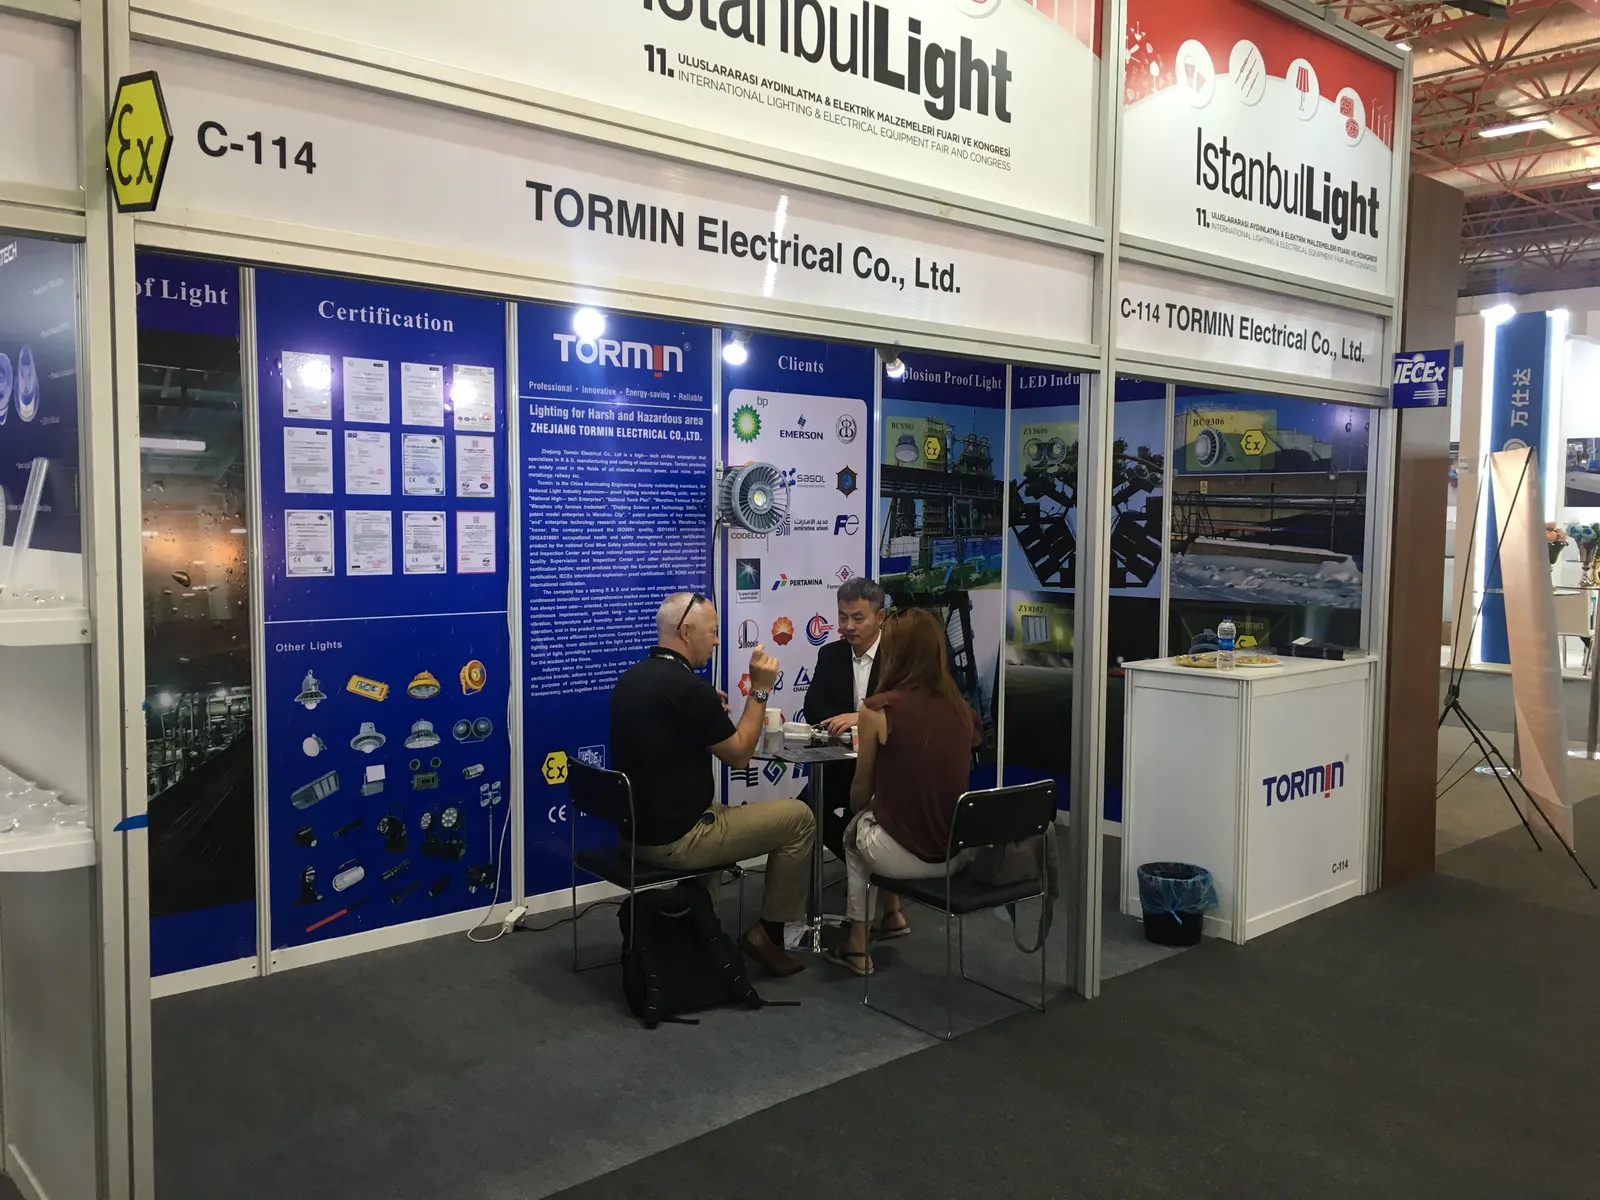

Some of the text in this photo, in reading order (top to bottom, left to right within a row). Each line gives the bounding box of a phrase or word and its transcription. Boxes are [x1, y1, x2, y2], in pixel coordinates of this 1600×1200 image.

[643, 0, 1012, 123] anbulLight
[644, 44, 674, 78] 11.
[678, 52, 1011, 158] ULUSLARARASI AYDINLATMA & ELEKTRİK MALZEMELERİ FUARI VE KONGRESİ
[678, 70, 1011, 171] INTERNATIONAL LIGHTING & ELECTRICAL EQUIPMENT FAIR AND CONGRESS
[196, 120, 316, 174] C-114
[1196, 127, 1380, 240] IstanbulLight
[1196, 208, 1210, 228] 11.
[526, 180, 960, 293] TORMIN Electrical Co., Ltd.
[1211, 212, 1249, 228] ULUSLARARASI
[1250, 222, 1280, 236] AYDINLATMA
[1338, 246, 1350, 255] FUARI
[1211, 222, 1251, 240] INTERNATIONAL
[1253, 234, 1275, 246] LIGHTING
[1280, 241, 1307, 254] ELECTRICAL
[1308, 248, 1333, 261] EQUIPMENT
[160, 279, 228, 308] Light
[318, 300, 454, 333] Certification
[1121, 297, 1365, 363] C-114 TORMIN Electrical Co., Ltd.
[778, 355, 824, 374] Clients
[1394, 360, 1446, 384] IECEx
[902, 367, 1002, 391] plosion Proof Light
[1019, 374, 1047, 389] LED
[529, 381, 703, 402] Professional Innovative Energy-saving Reliable
[756, 395, 769, 408] bp
[1510, 368, 1531, 427] 万仕达
[530, 404, 704, 425] Lighting for Harsh and Hazardous area
[1193, 417, 1225, 426] BC9306
[530, 423, 576, 435] ZHEJIANG
[579, 425, 614, 437] TORMIN
[616, 427, 667, 440] ELECTRICAL
[780, 430, 824, 440] EMERSON
[276, 640, 343, 652] Other Lights
[548, 804, 566, 823] CE
[1332, 860, 1348, 873] C-114
